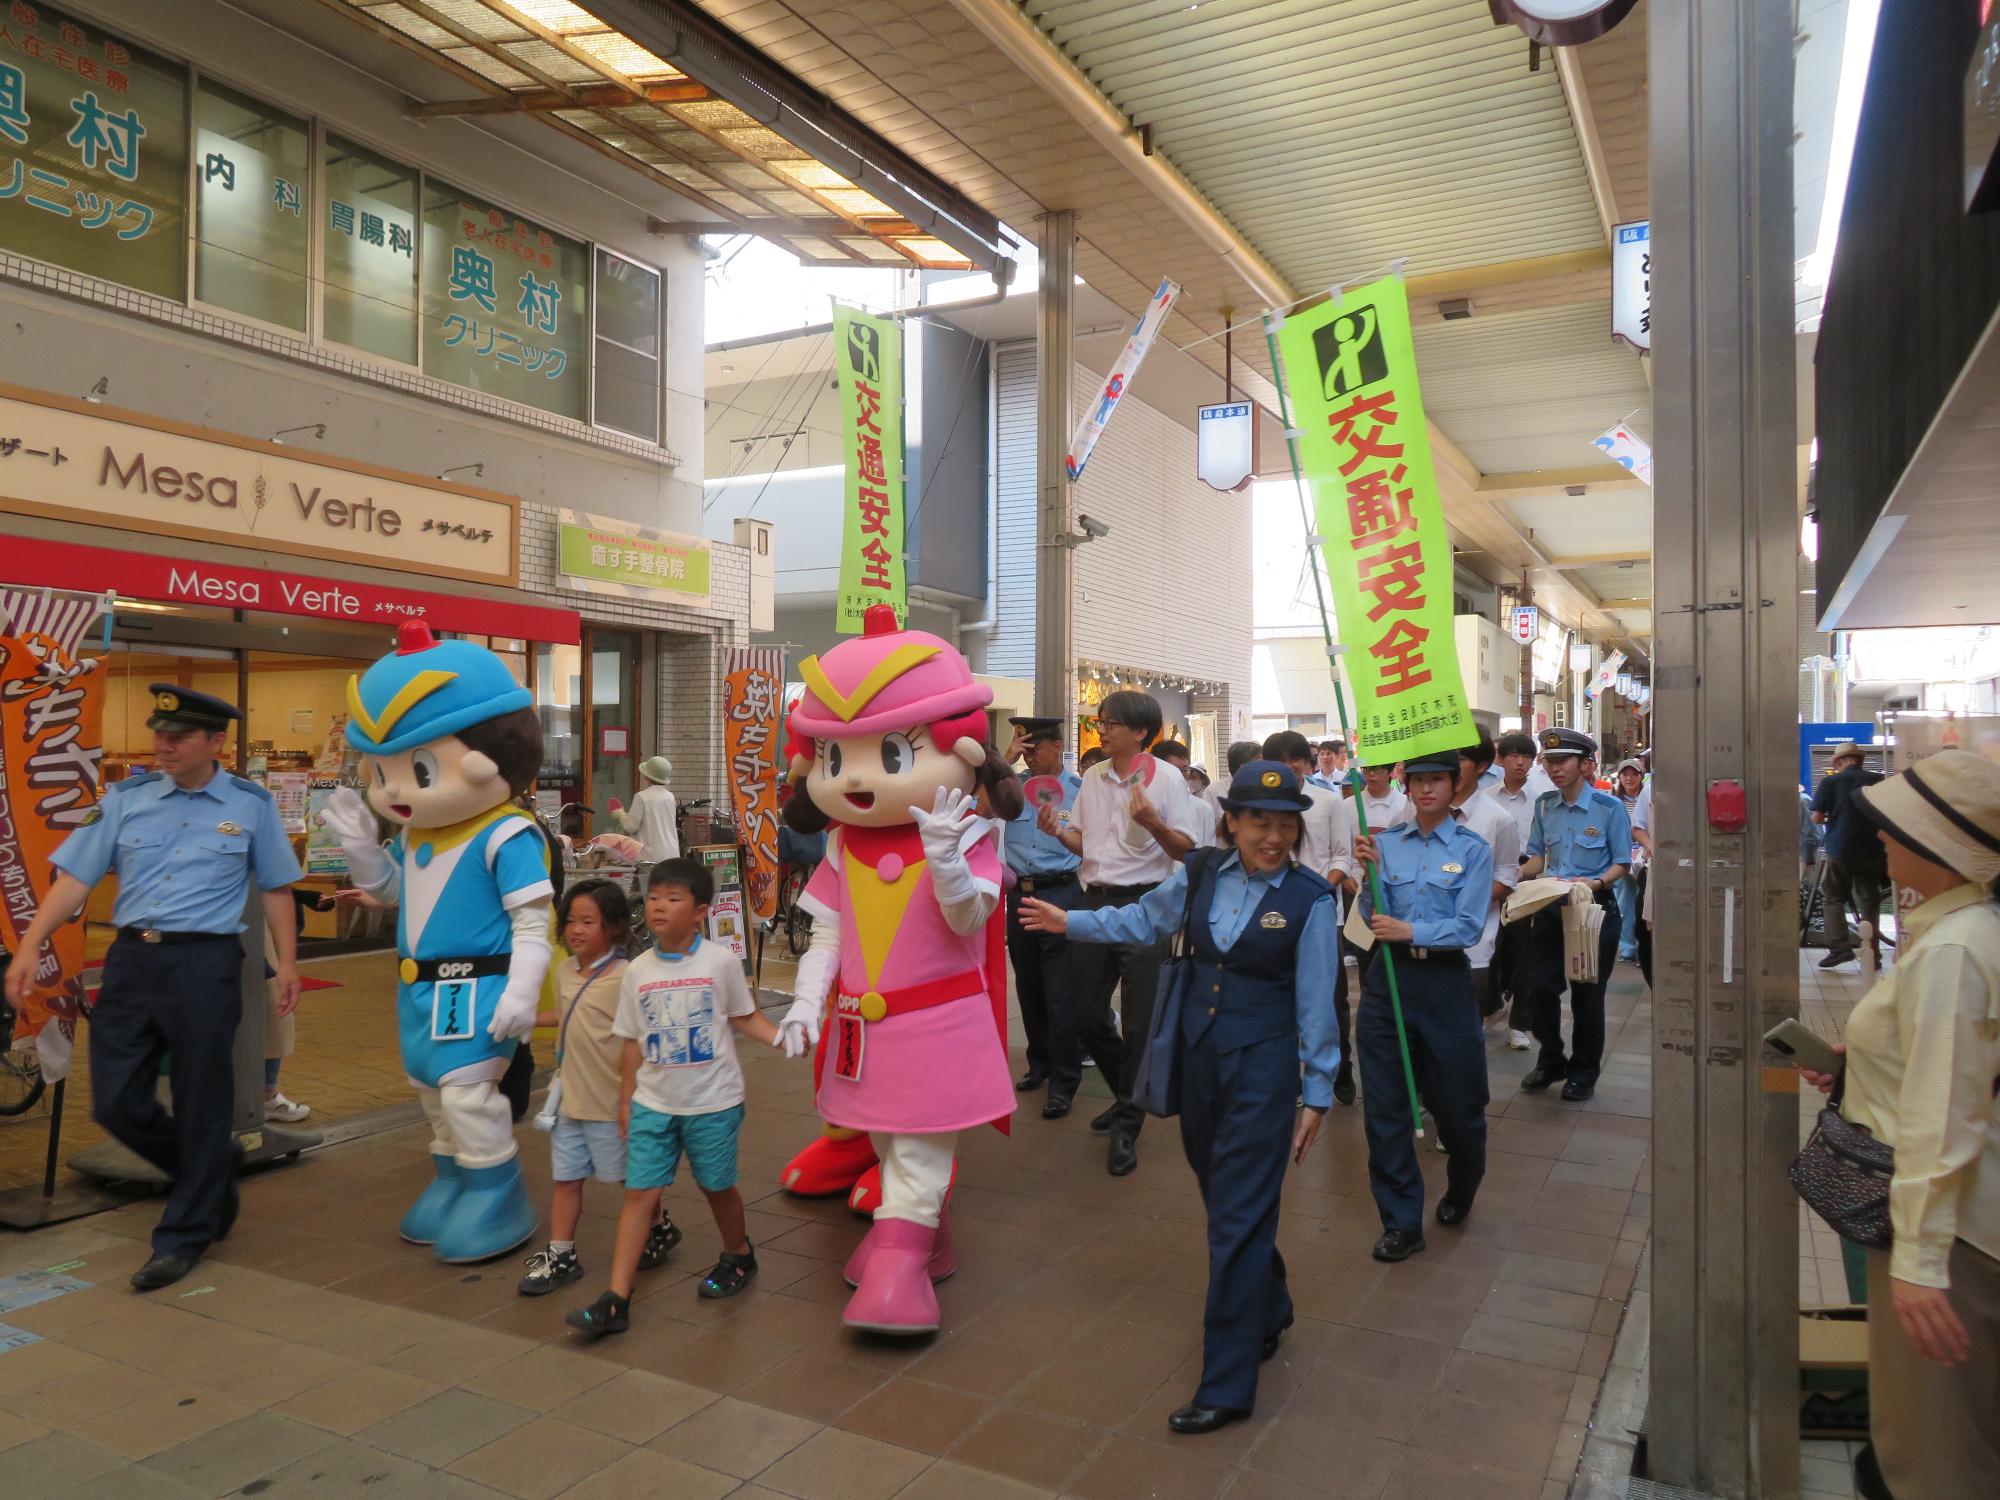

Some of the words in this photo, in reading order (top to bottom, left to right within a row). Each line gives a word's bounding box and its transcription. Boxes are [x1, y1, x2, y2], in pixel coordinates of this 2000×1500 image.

[330, 199, 414, 259] 胃腸科
[462, 219, 553, 271] 老人在宅医療
[448, 245, 562, 336] 奥村
[442, 313, 568, 380] クリニック
[98, 445, 238, 510] Mesa
[289, 482, 402, 537] Verte
[853, 379, 893, 592] 交通安全
[419, 518, 495, 544] メサベルテ
[168, 567, 261, 604] Mesa
[279, 580, 361, 615] Verte
[373, 602, 427, 618] メサベルテ
[437, 962, 475, 978] OPP
[443, 983, 463, 1036] フーくん
